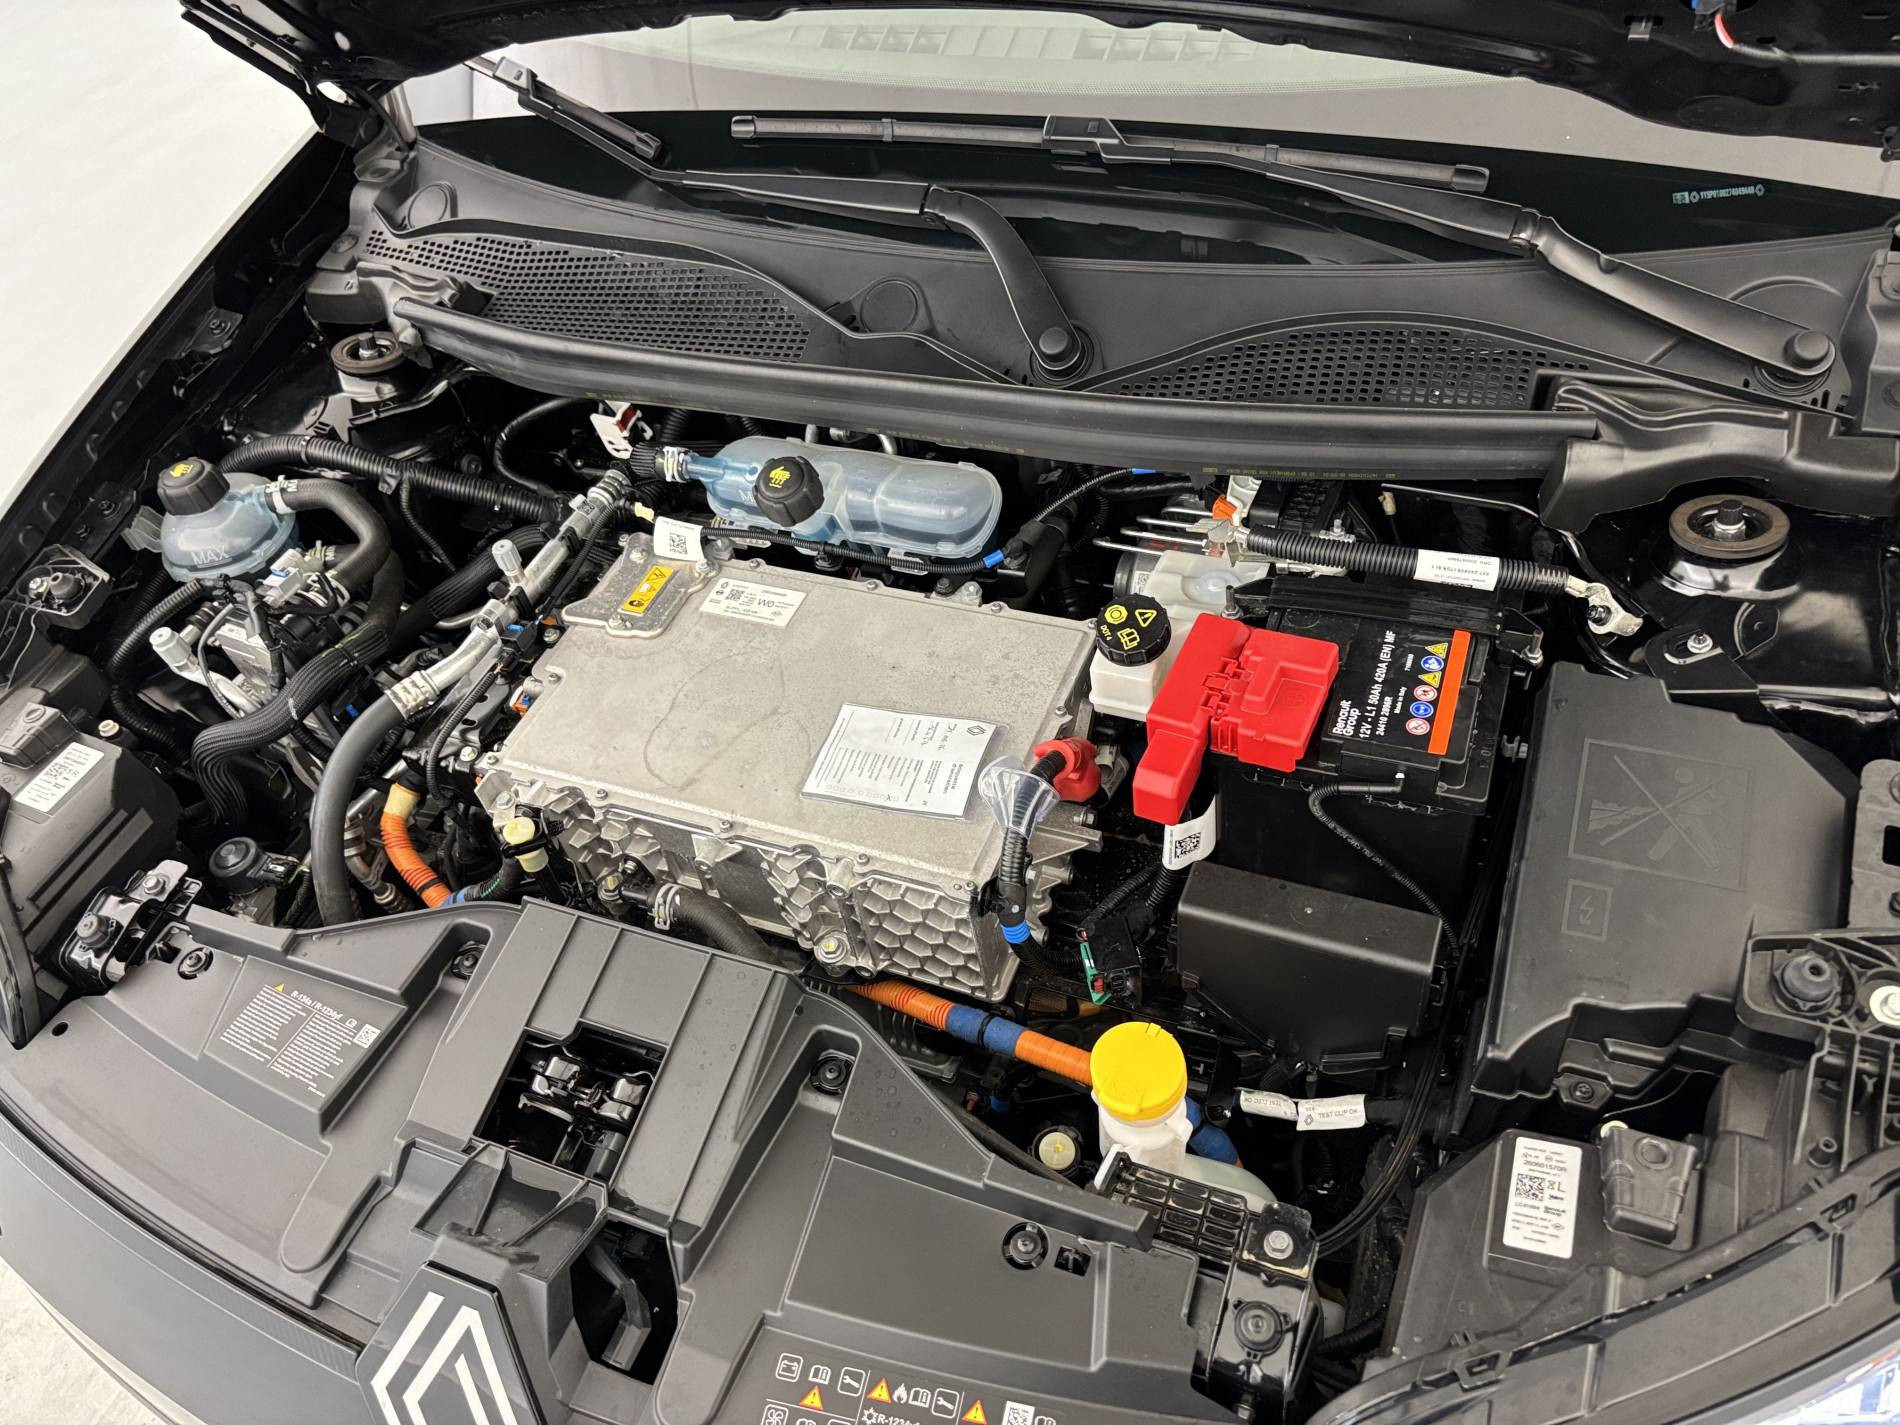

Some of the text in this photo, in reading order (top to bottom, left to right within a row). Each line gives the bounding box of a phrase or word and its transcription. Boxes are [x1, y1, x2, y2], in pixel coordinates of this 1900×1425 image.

[191, 547, 230, 565] MAX
[1101, 625, 1111, 636] DOT
[1384, 630, 1396, 643] MF
[1380, 643, 1395, 662] (EN)
[1374, 662, 1388, 682] 420A
[1368, 684, 1383, 705] 50Ah
[1333, 700, 1352, 734] Renault
[1365, 706, 1376, 717] L1
[1343, 708, 1361, 736] Group
[1359, 723, 1372, 738] 12V
[1376, 714, 1388, 736] 24410
[314, 1001, 343, 1021] R-1234yf
